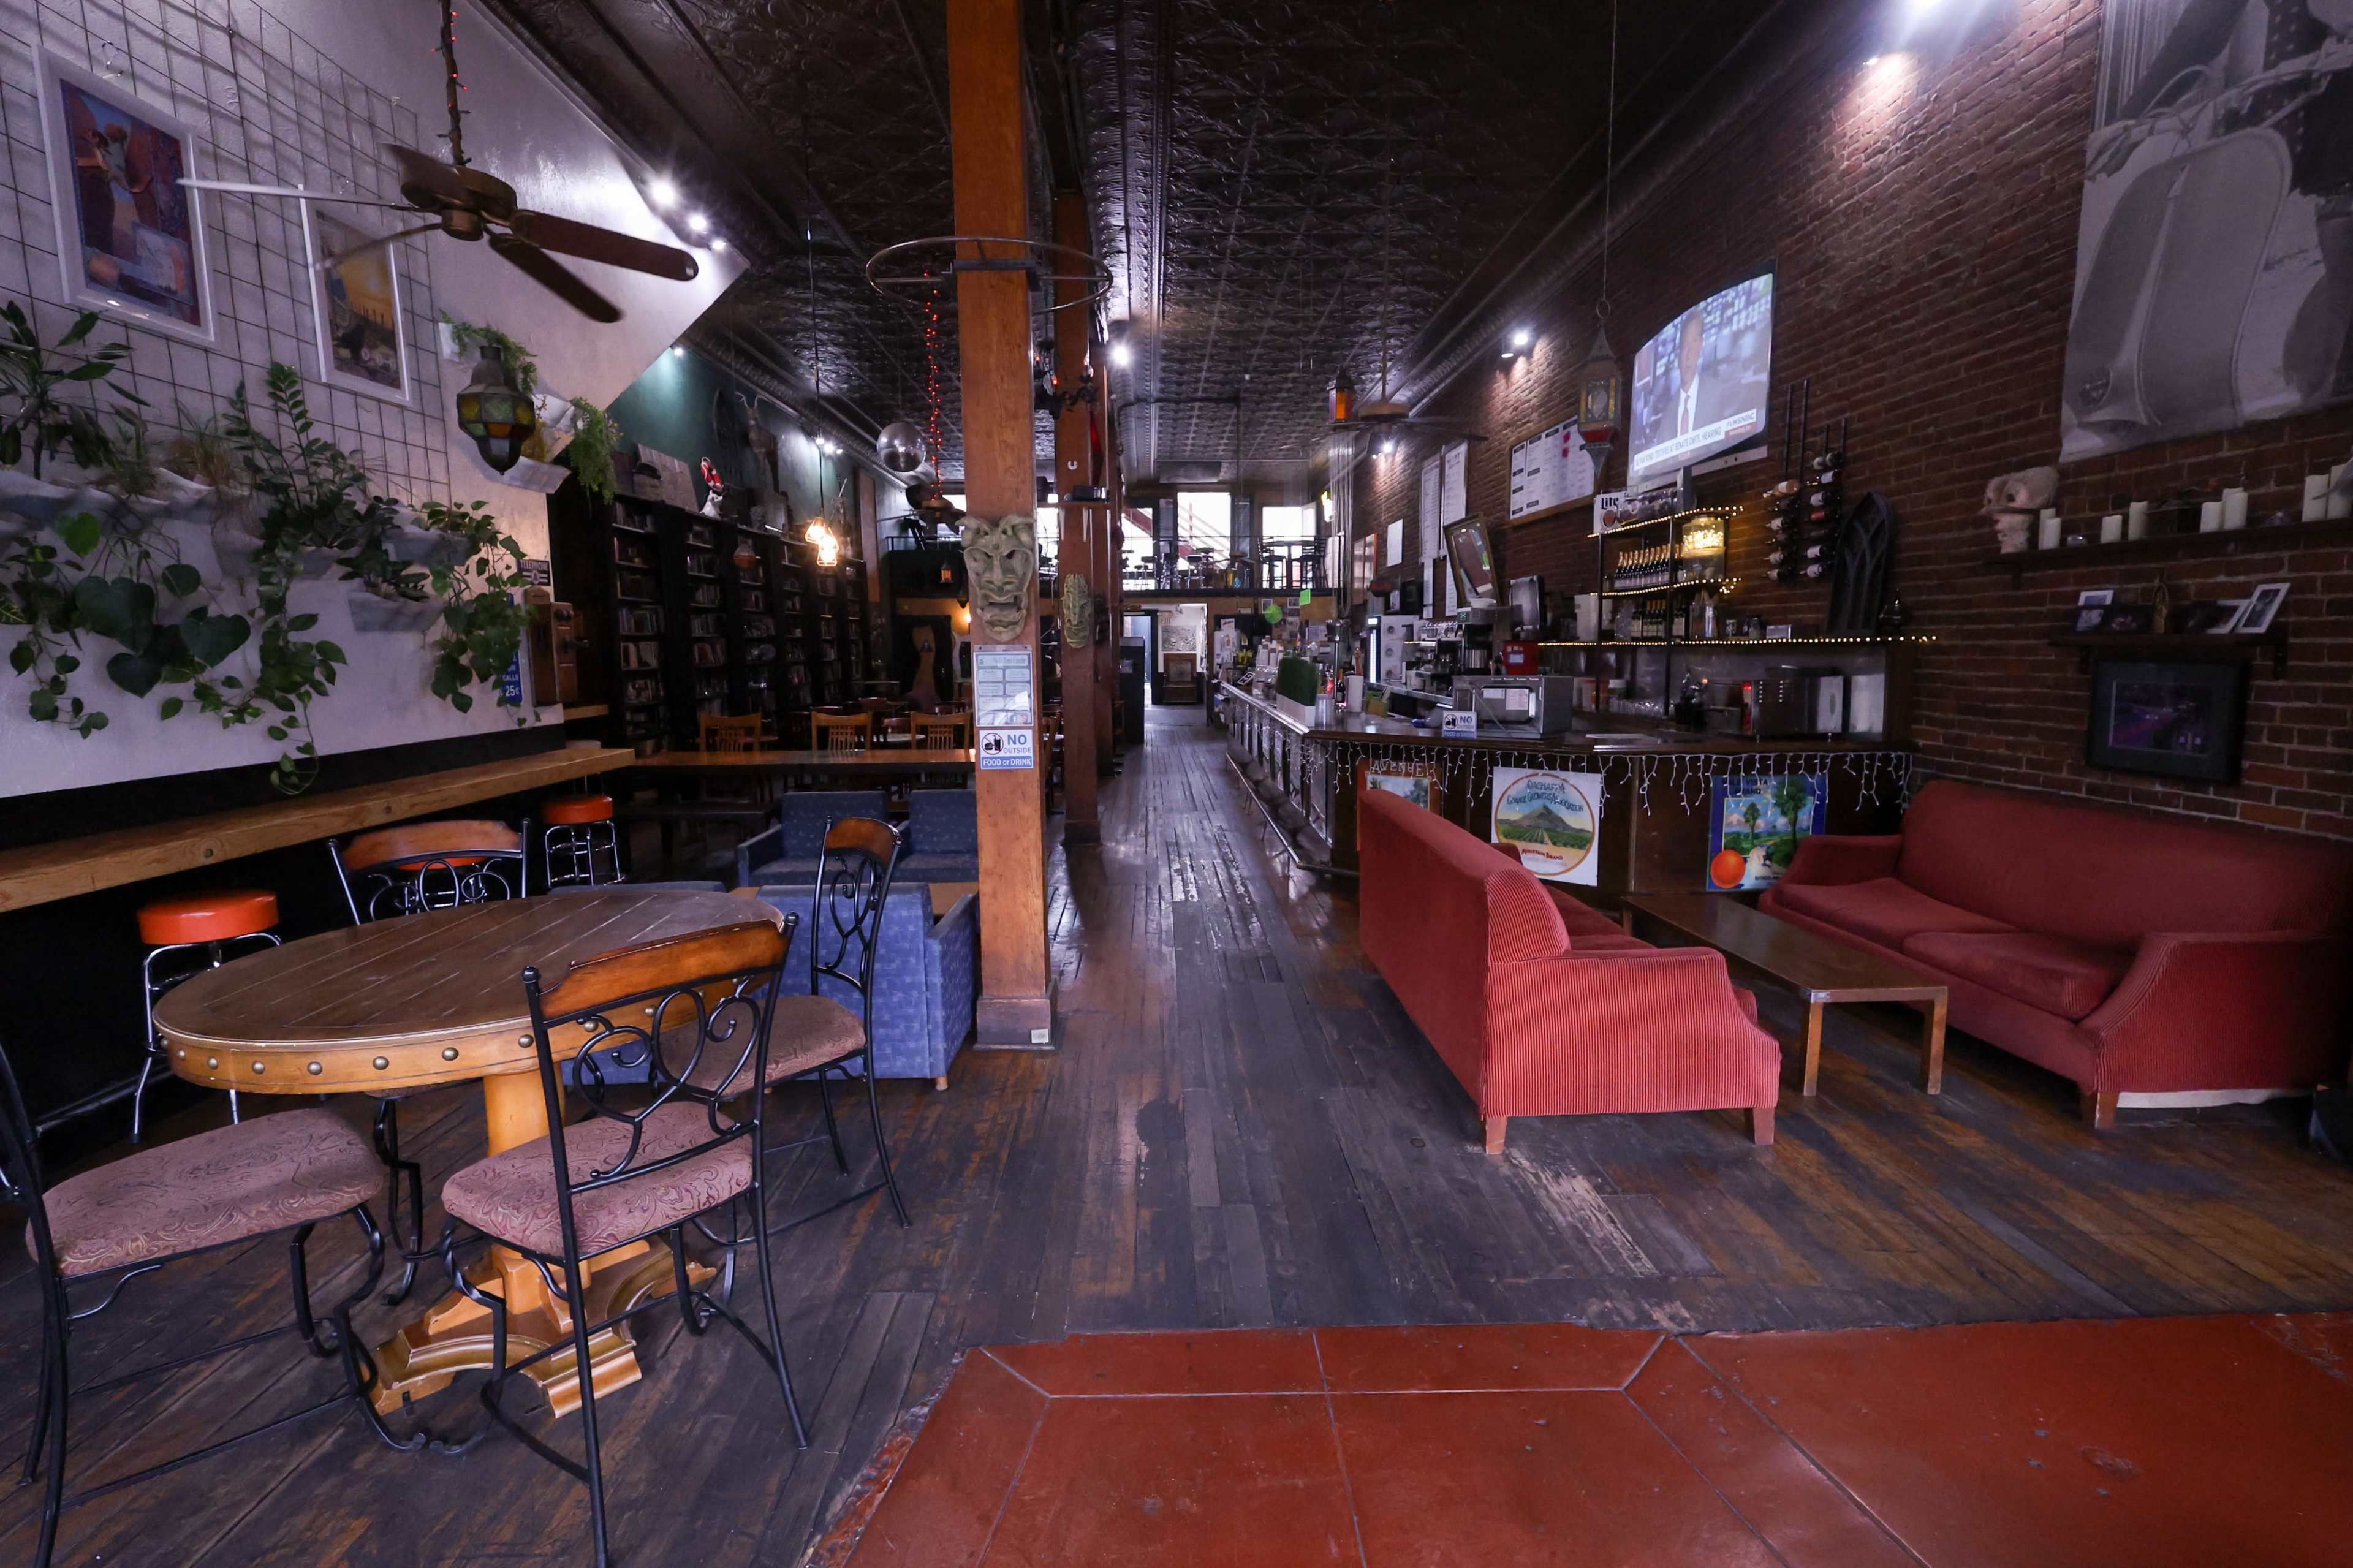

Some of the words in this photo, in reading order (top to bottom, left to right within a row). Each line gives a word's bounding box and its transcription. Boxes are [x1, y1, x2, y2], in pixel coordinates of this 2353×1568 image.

[1702, 426, 1721, 441] HEARING
[1601, 497, 1618, 510] Lite
[1007, 734, 1027, 745] NO
[1371, 760, 1423, 776] AVENUE
[1550, 793, 1584, 812] ASSOCIATION
[1546, 852, 1563, 860] BRAND
